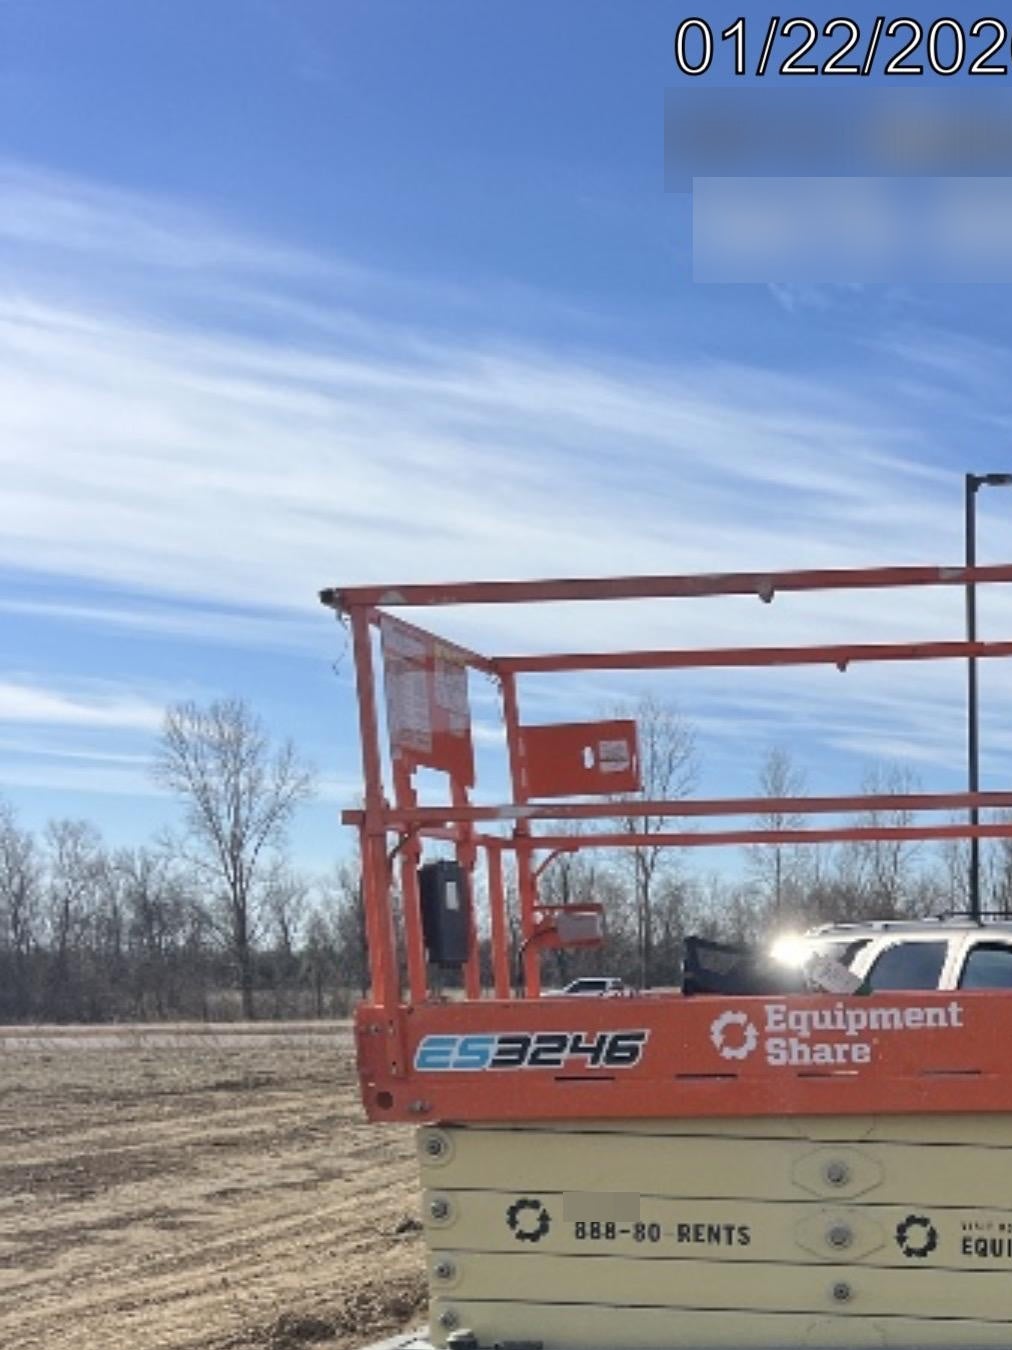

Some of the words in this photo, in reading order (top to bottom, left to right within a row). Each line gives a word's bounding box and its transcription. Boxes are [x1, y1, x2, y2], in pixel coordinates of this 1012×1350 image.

[764, 1002, 964, 1038] Equipment
[414, 1029, 651, 1072] ES3246
[766, 1037, 871, 1066] Share
[574, 1221, 661, 1243] 888-80
[677, 1223, 751, 1246] RENTS
